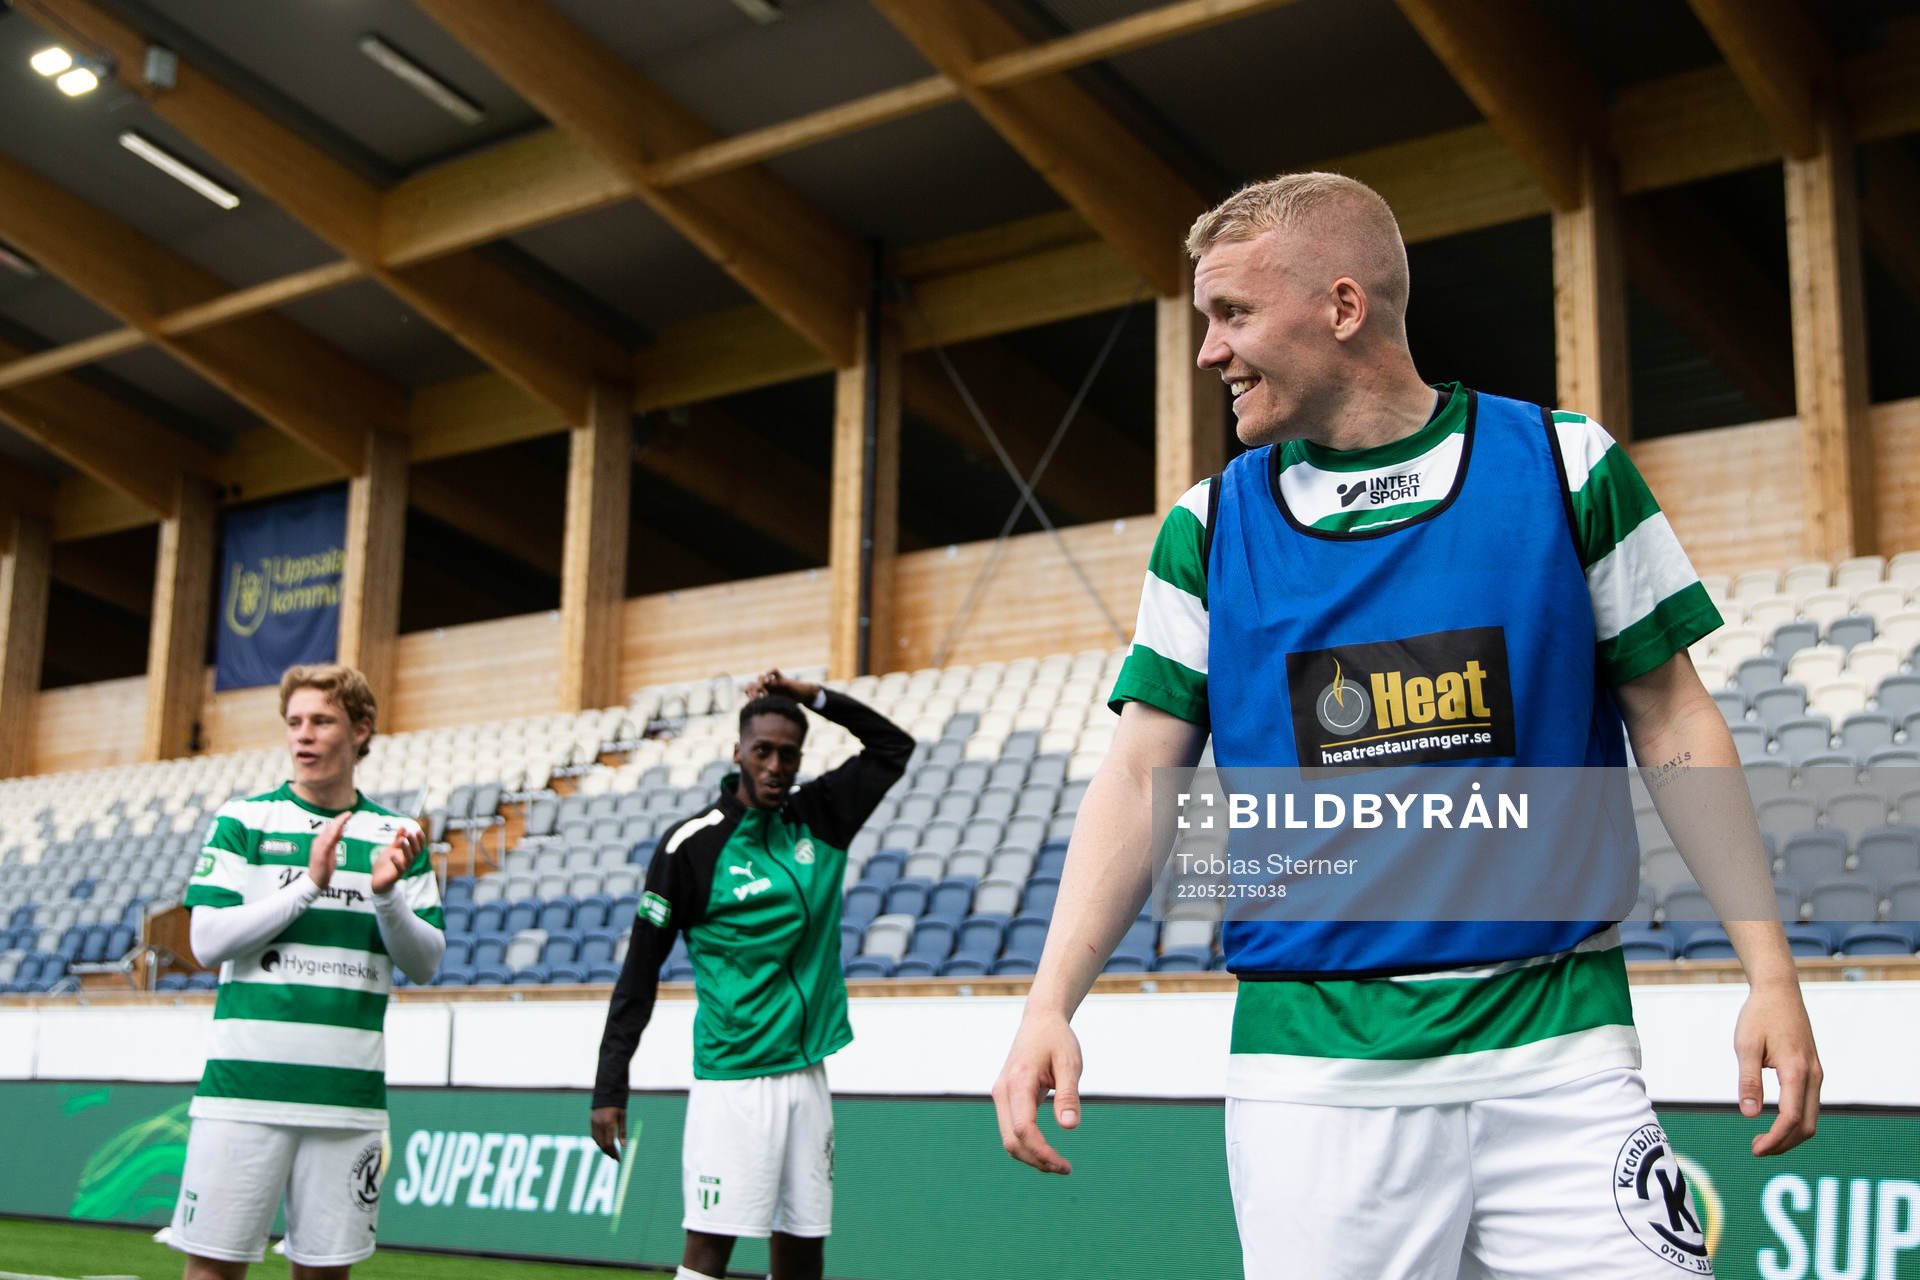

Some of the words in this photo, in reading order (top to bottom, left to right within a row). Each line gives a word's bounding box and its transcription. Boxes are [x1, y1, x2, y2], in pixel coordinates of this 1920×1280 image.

[1370, 473, 1420, 490] INTER
[1370, 485, 1420, 504] SPORT
[1370, 660, 1491, 730] Heat
[1321, 732, 1492, 764] heatrestauranger.se
[1650, 751, 1692, 783] Alexis
[1660, 1244, 1685, 1263] 070
